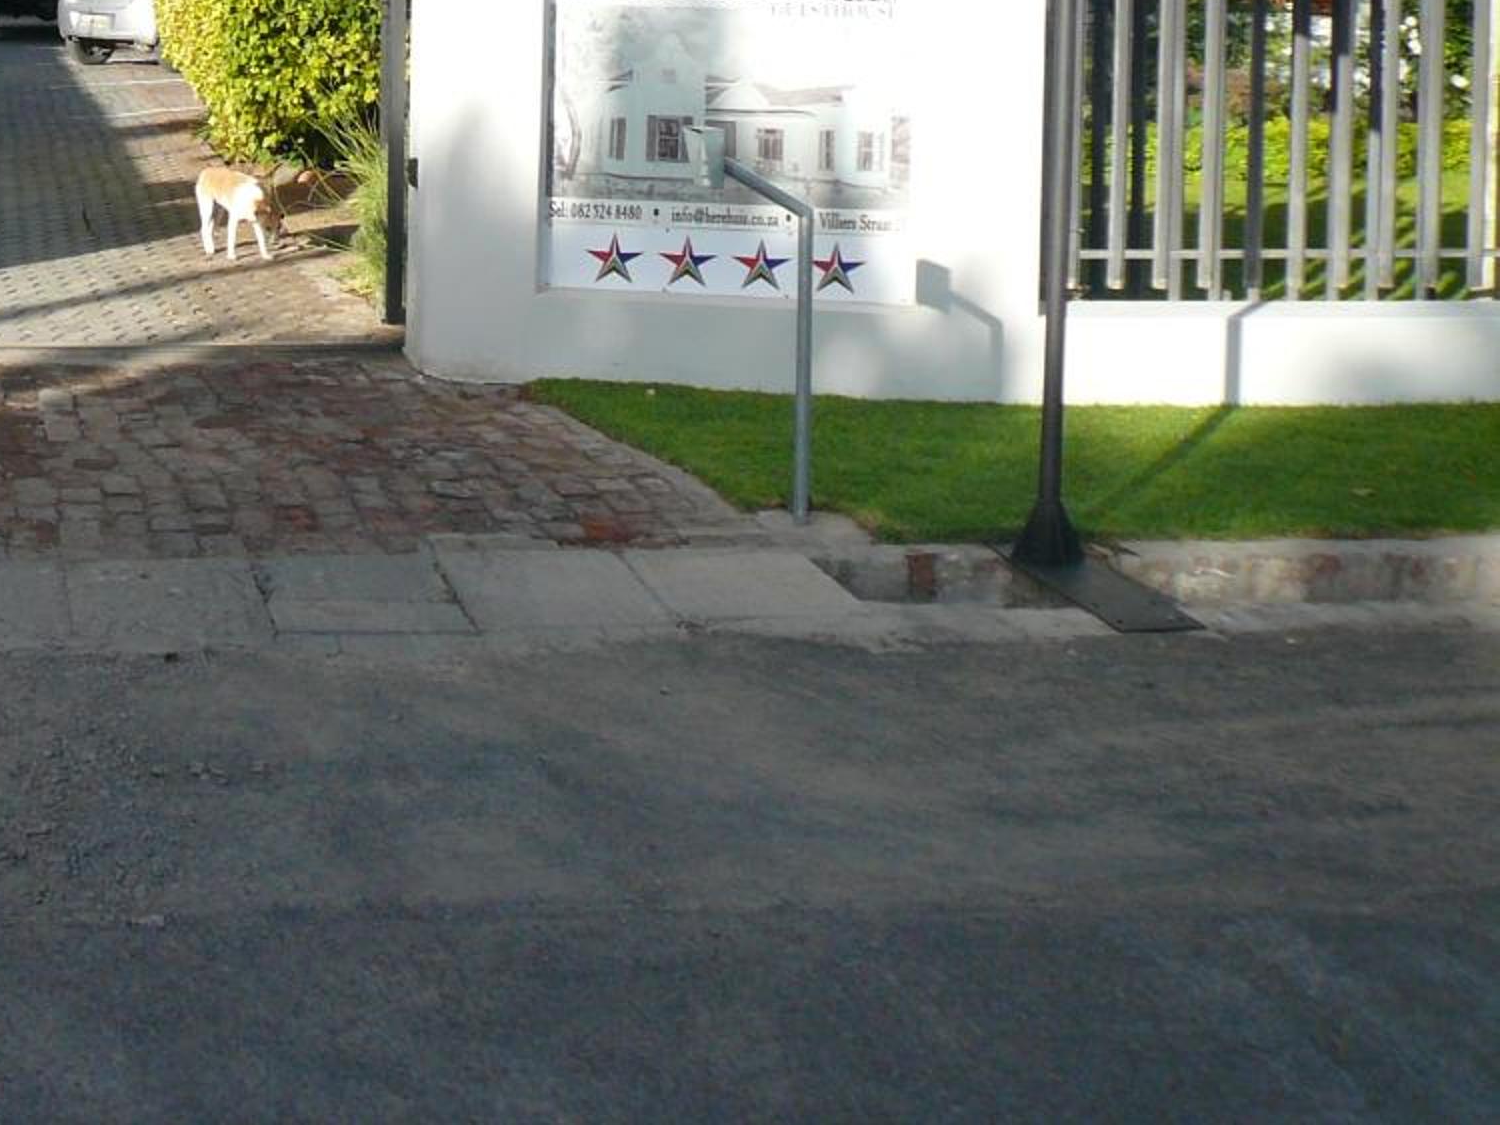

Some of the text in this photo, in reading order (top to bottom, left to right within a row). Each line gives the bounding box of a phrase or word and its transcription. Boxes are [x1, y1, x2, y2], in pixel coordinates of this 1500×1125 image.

[571, 202, 591, 220] 082
[593, 203, 613, 221] 524
[615, 204, 644, 221] 8480
[819, 212, 857, 231] Villiers
[859, 213, 895, 232] Straa
